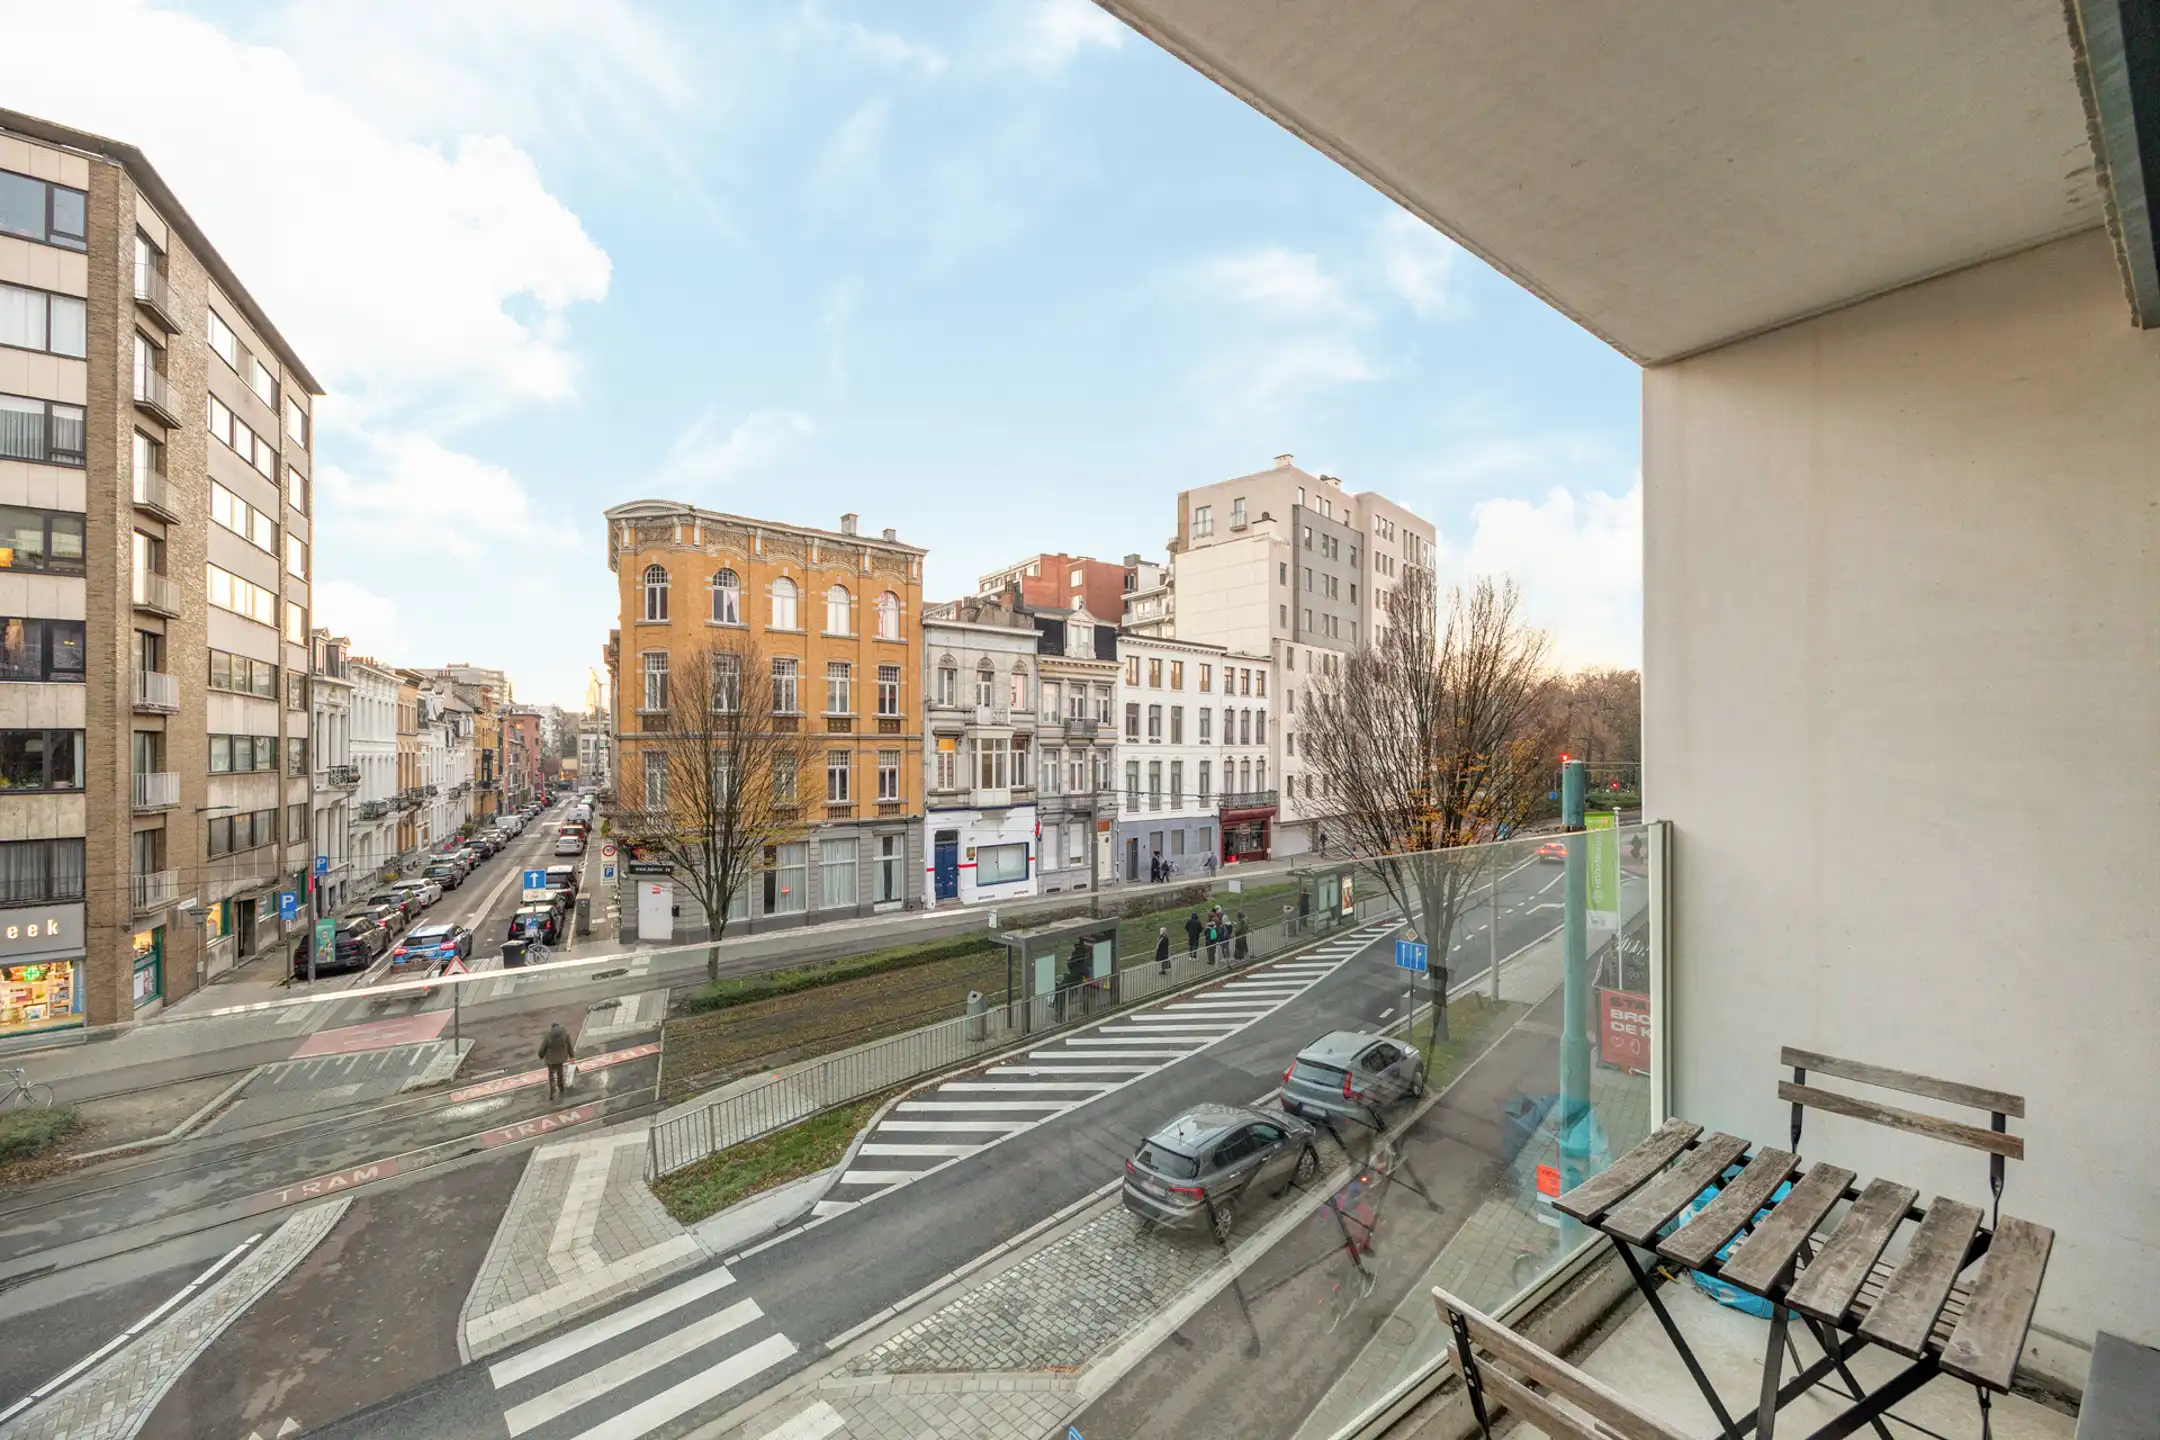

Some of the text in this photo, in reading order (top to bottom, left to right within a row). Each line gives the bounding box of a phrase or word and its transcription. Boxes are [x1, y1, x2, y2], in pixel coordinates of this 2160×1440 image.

[316, 858, 326, 869] P
[282, 895, 295, 909] P
[1610, 1021, 1637, 1035] DE
[498, 1111, 581, 1139] TRAM
[275, 1166, 379, 1202] TRAM
